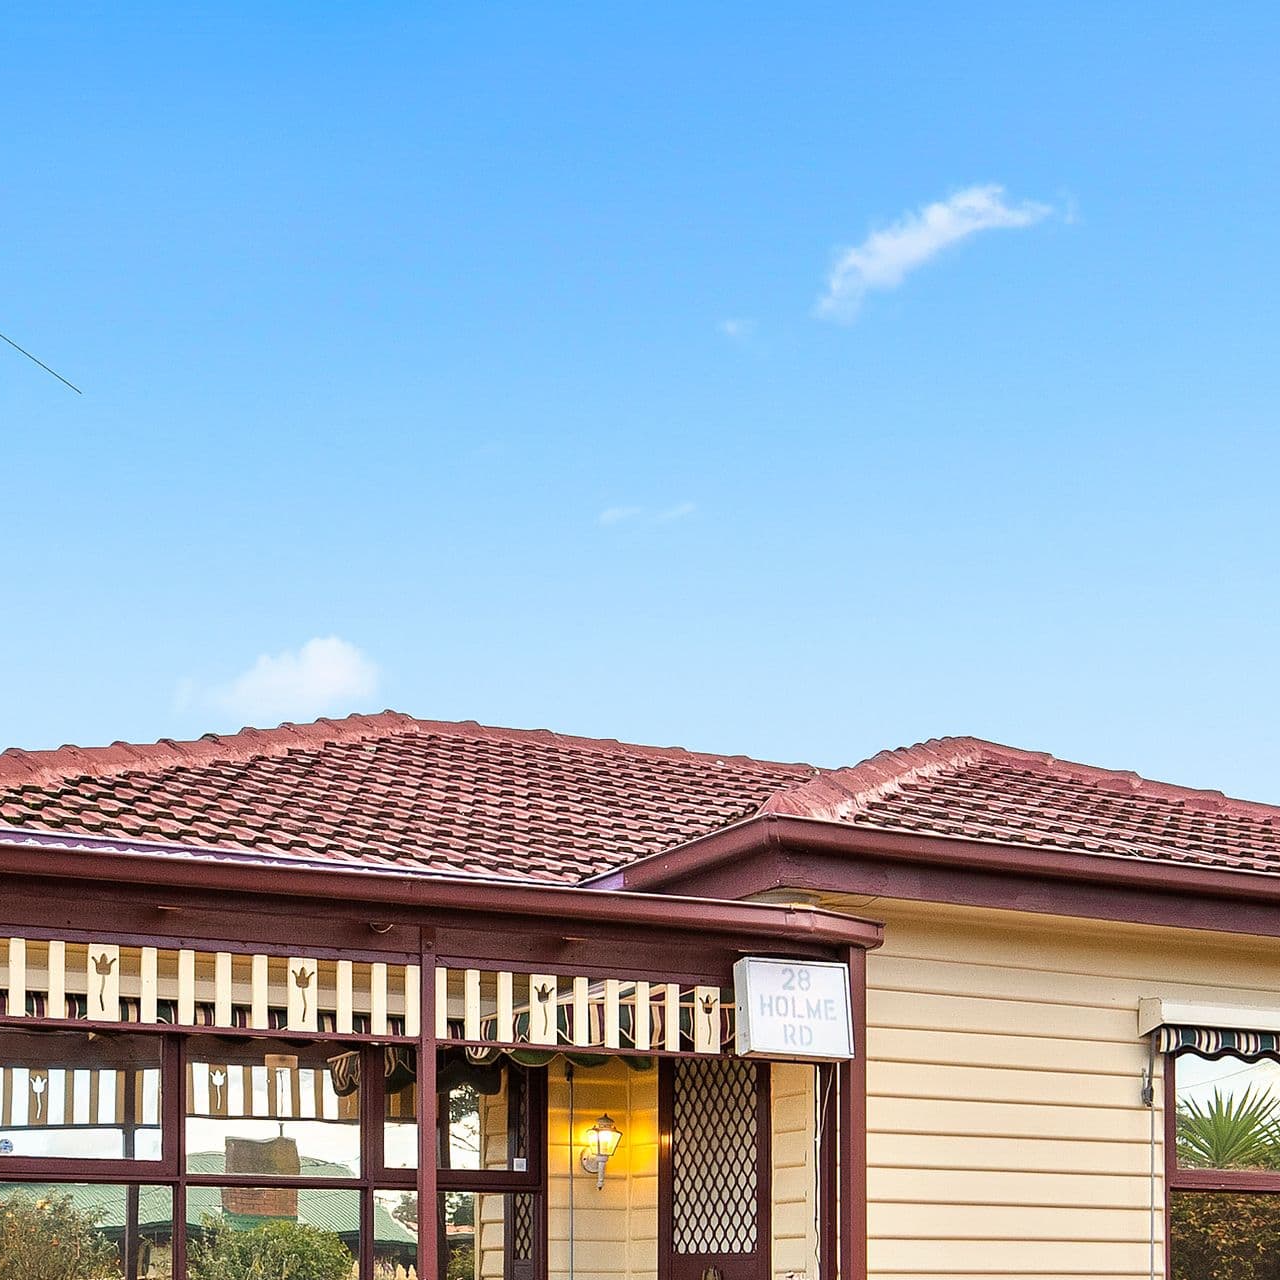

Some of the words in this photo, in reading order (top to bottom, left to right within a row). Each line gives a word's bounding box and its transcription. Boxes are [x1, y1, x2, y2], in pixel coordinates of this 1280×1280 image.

[781, 967, 812, 992] 28
[759, 994, 838, 1021] HOLME
[783, 1024, 813, 1047] RD
